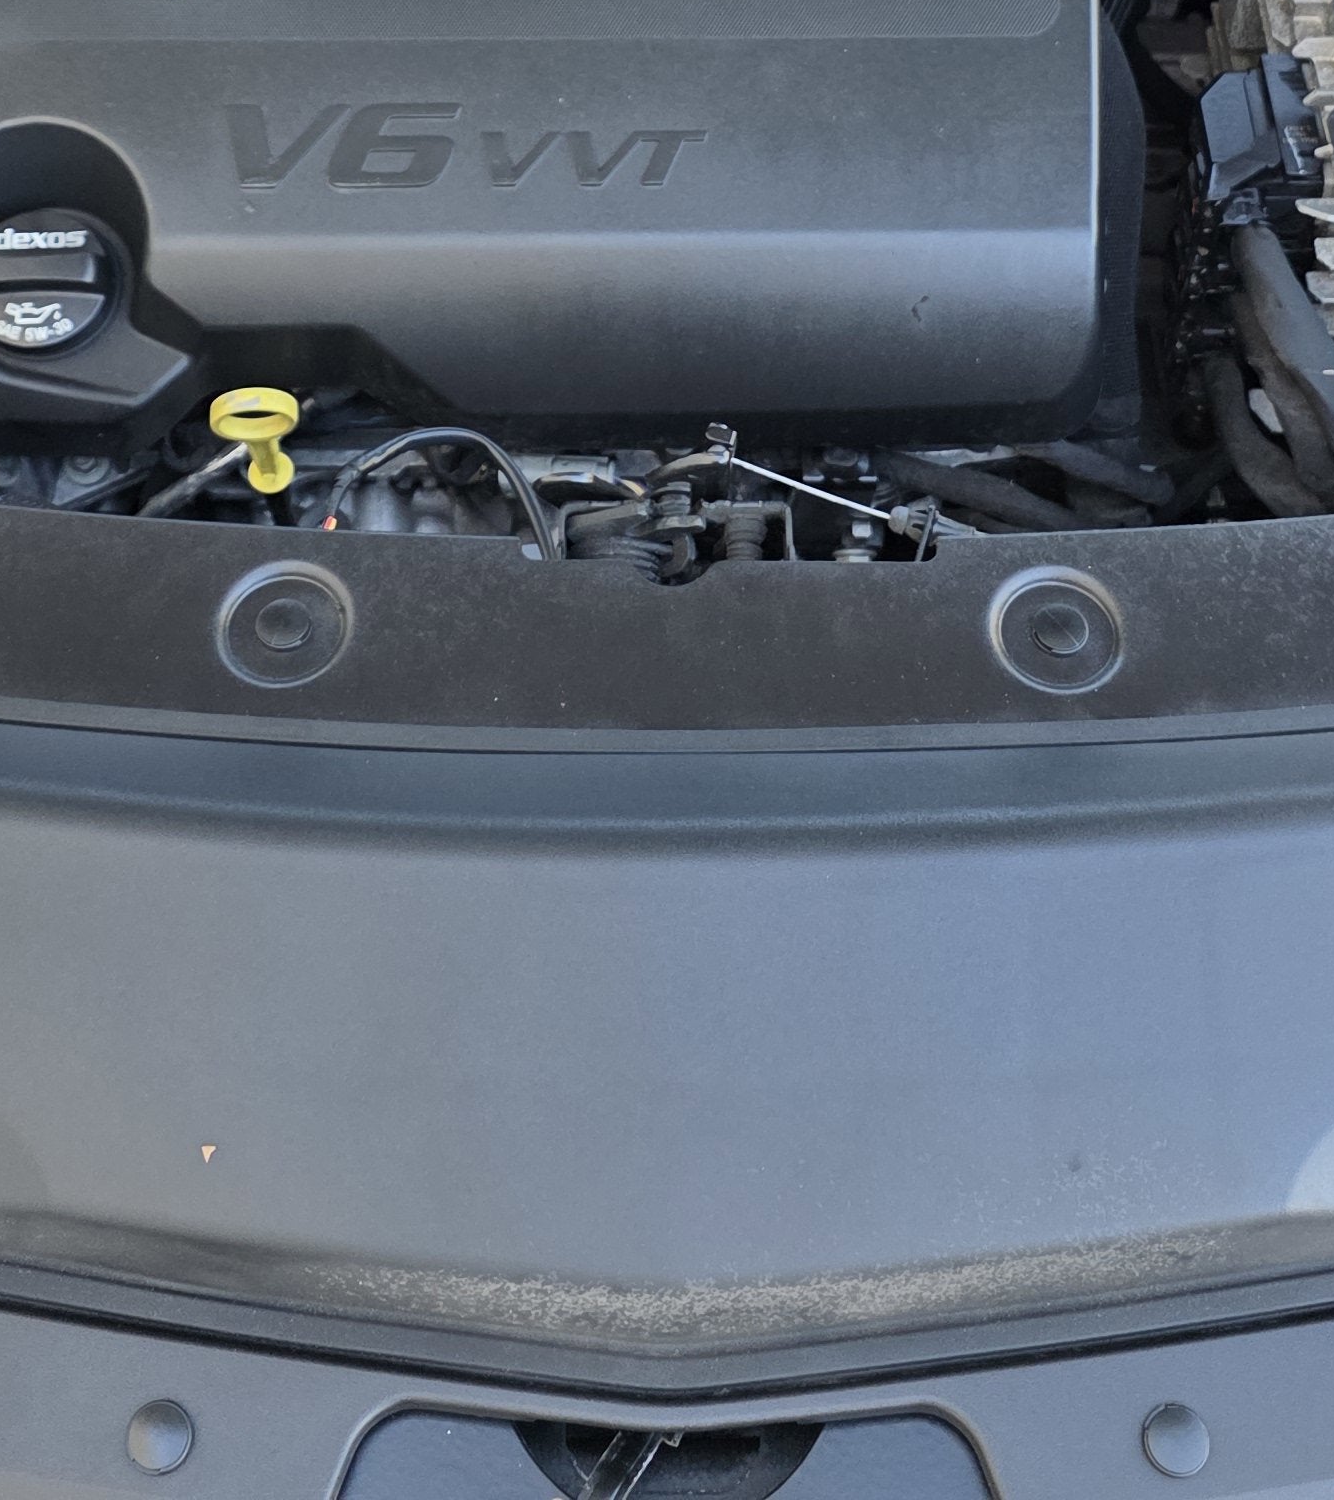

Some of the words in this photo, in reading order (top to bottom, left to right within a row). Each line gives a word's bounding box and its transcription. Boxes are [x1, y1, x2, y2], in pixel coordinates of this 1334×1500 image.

[224, 101, 465, 190] V6
[480, 129, 709, 188] VVT
[23, 317, 75, 343] 5W-30
